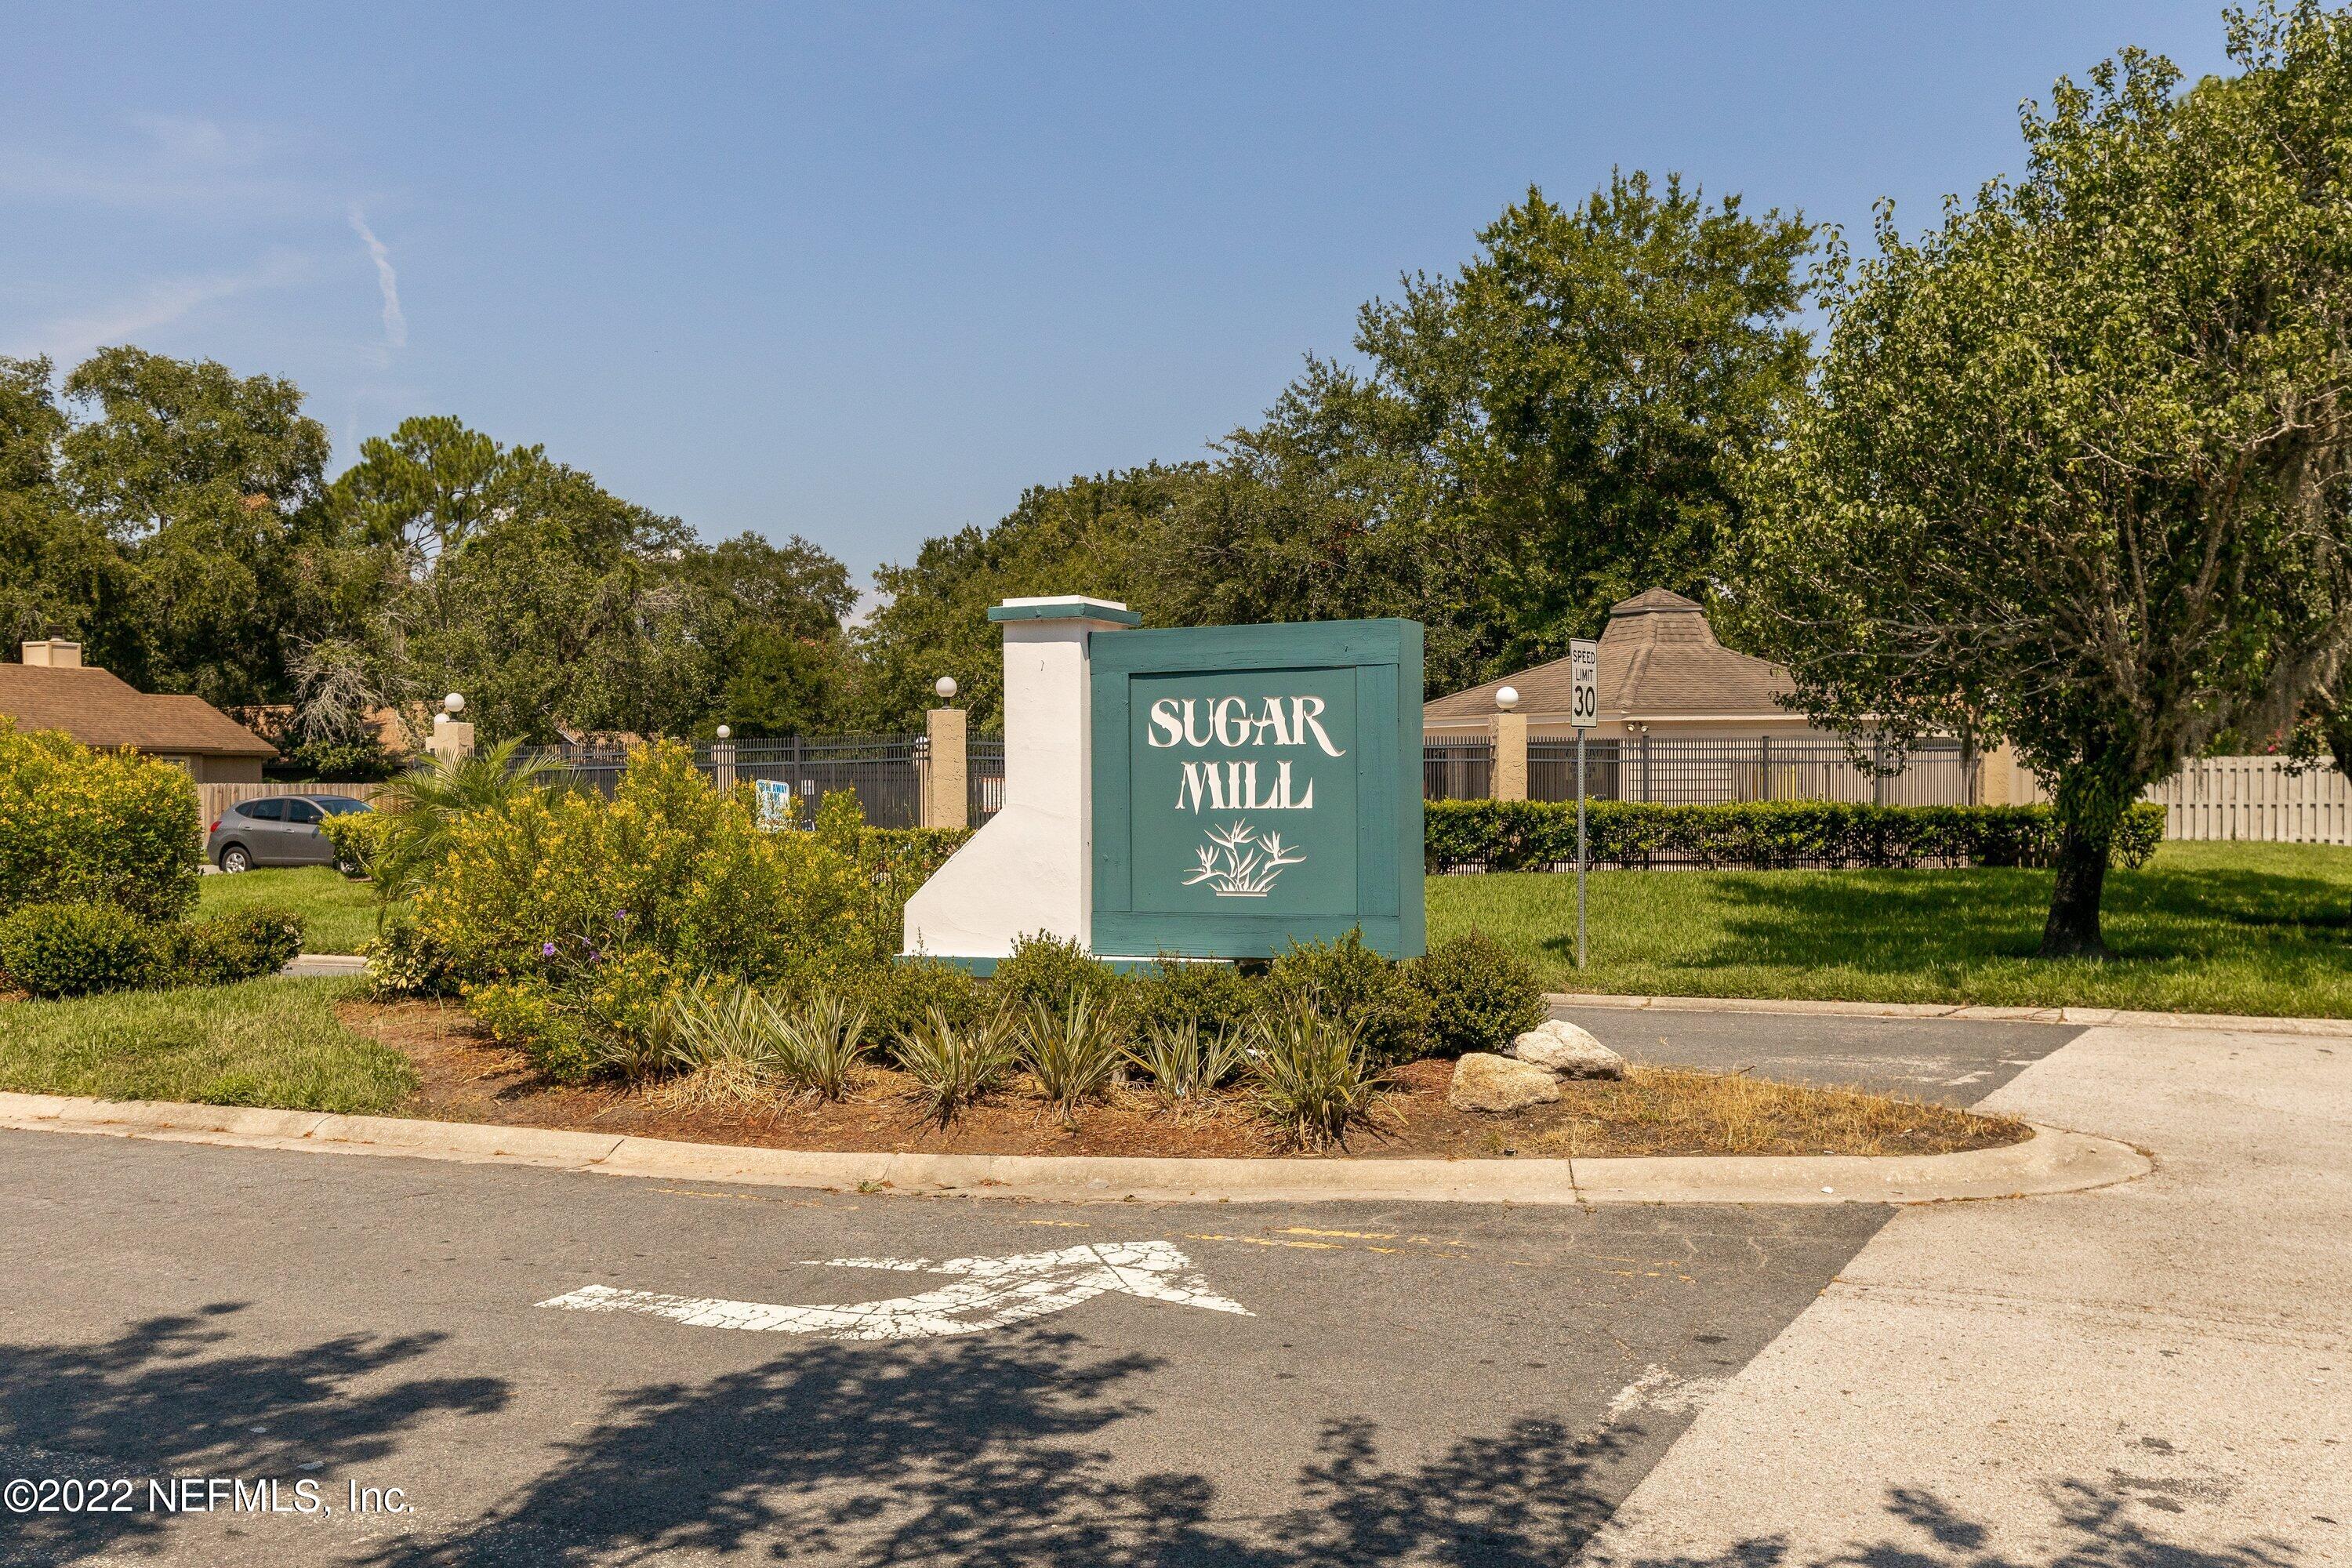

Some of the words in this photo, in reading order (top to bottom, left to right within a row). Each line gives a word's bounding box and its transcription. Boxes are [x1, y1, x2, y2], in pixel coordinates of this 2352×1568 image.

[1573, 649, 1595, 665] SPEED
[1575, 668, 1593, 682] LIMIT
[1573, 685, 1595, 717] 30
[1148, 695, 1346, 757] SUGAR
[772, 783, 787, 793] AWAY
[1174, 760, 1313, 815] MILL
